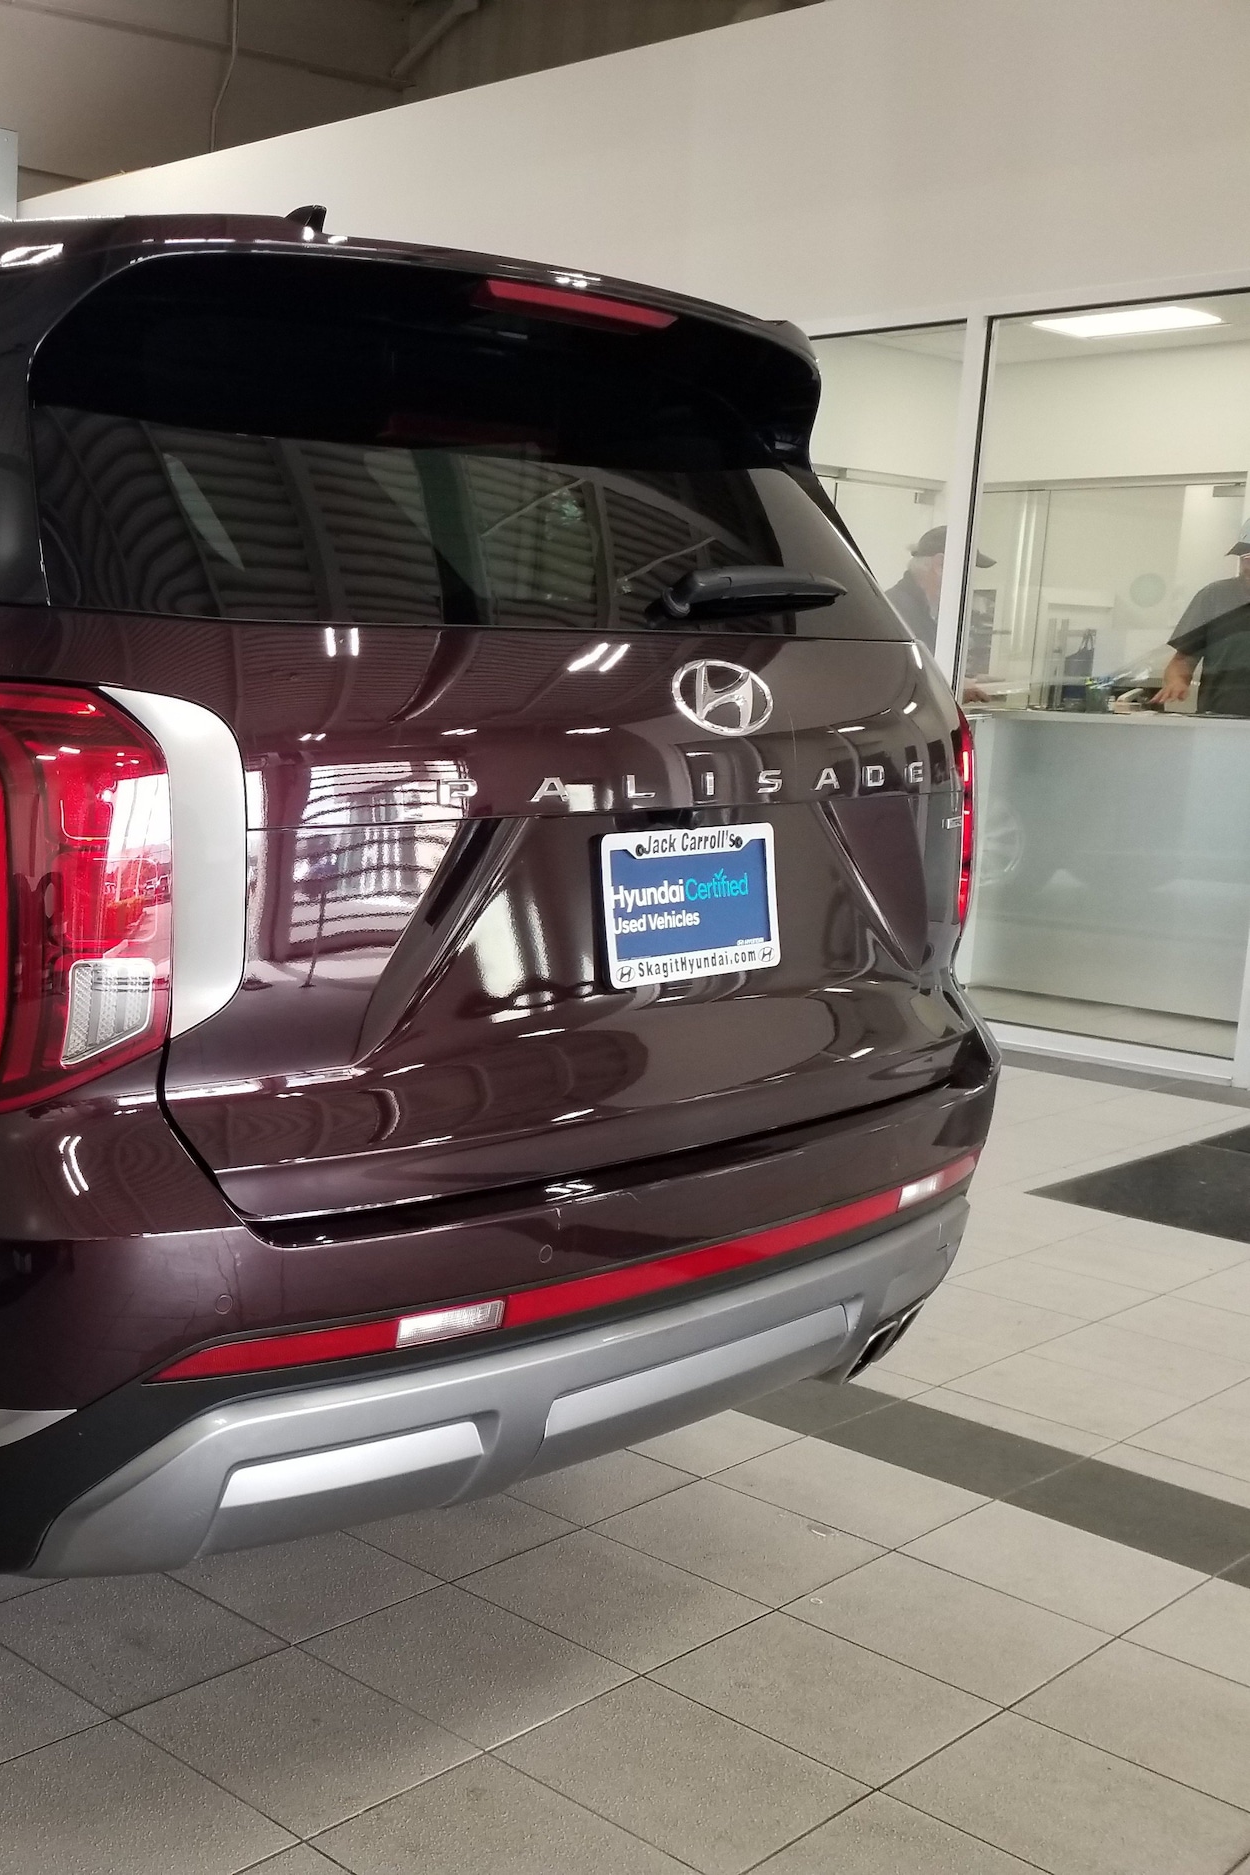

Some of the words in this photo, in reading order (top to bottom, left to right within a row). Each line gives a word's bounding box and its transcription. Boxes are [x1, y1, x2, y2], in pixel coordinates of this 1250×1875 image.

[436, 760, 924, 803] PALISADE
[644, 833, 677, 855] Jack
[681, 829, 735, 851] Carroll's
[611, 878, 685, 913] Hyundai
[612, 913, 647, 935] Used
[648, 909, 701, 931] Vehicles
[637, 949, 757, 978] SkagitHyundai.com
